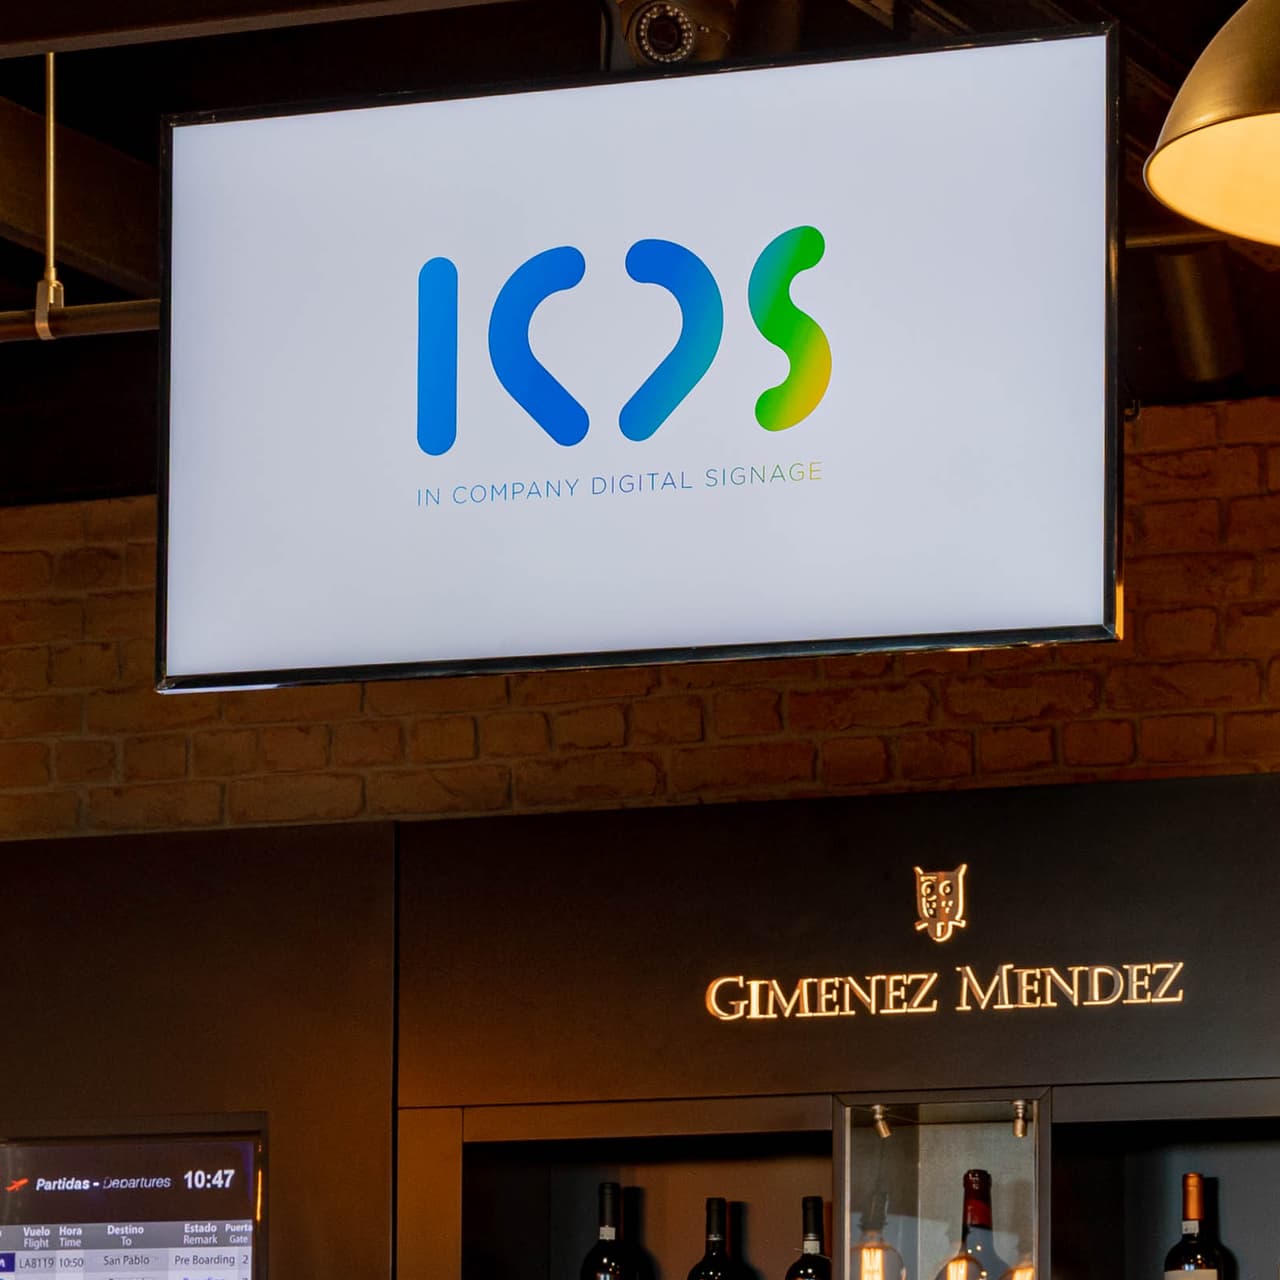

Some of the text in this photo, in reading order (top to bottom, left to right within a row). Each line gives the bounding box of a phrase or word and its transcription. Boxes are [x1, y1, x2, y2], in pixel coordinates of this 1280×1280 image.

[417, 461, 823, 507] IN COMPANY DIGITAL SIGNAGE
[705, 961, 1185, 1021] GIMENEZ MENDEZ
[35, 1169, 235, 1191] Partidas Departures 10:47
[23, 1227, 51, 1237] Vuelo
[59, 1226, 82, 1236] Hora
[107, 1225, 145, 1235] Destino
[184, 1223, 217, 1233] Estado
[225, 1223, 253, 1232] Puerta
[23, 1238, 49, 1250] Flight
[59, 1237, 81, 1247] Time
[120, 1236, 132, 1246] To
[183, 1235, 218, 1245] Remark
[229, 1235, 248, 1244] Gate
[59, 1257, 84, 1268] 10:50
[103, 1255, 121, 1266] San
[122, 1255, 150, 1265] Pablo
[174, 1255, 190, 1265] Pre
[192, 1254, 236, 1267] Boarding
